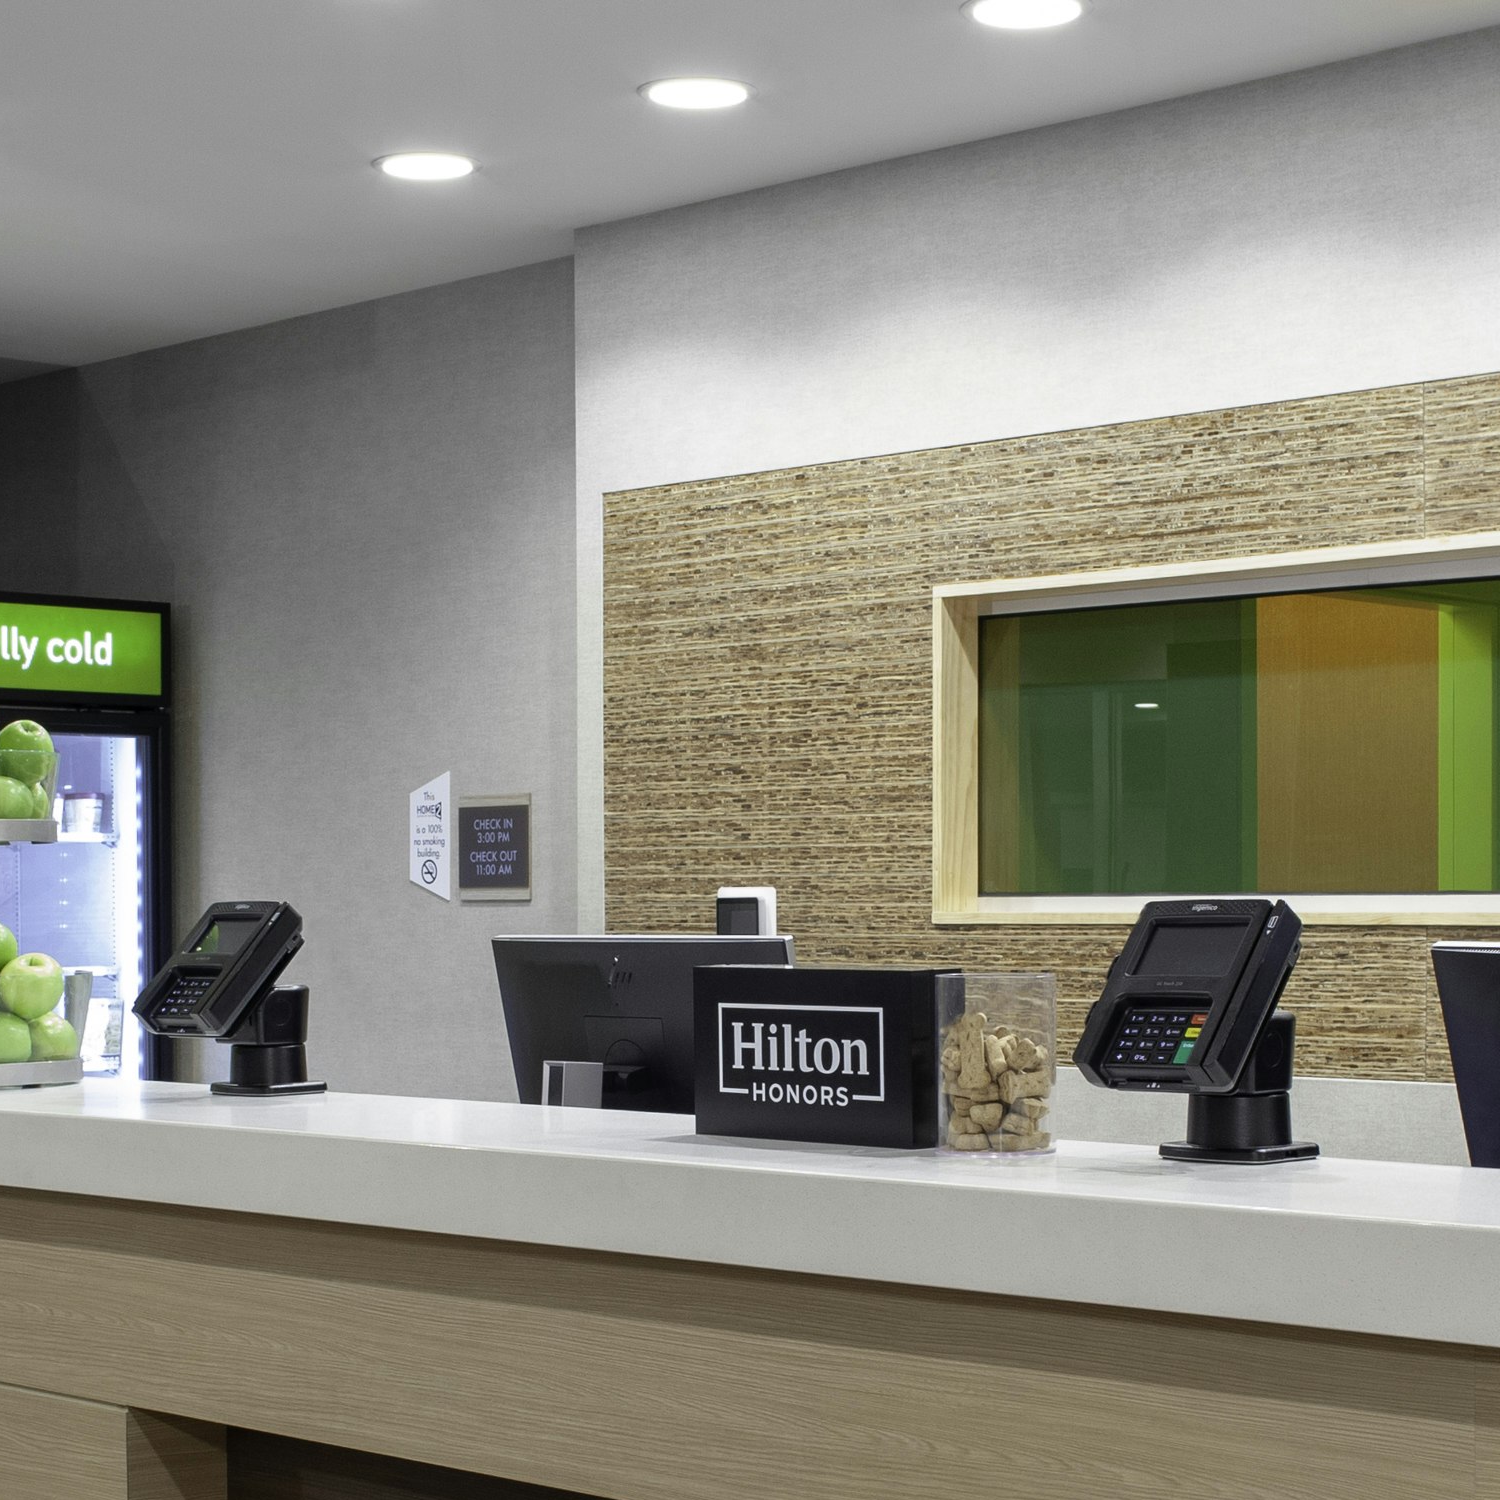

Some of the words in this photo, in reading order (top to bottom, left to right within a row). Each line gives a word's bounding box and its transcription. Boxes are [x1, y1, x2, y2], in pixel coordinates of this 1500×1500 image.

[46, 631, 113, 666] cold
[424, 792, 435, 801] This
[416, 825, 421, 834] is
[428, 824, 443, 834] 100%
[473, 819, 501, 831] CHECK
[503, 819, 513, 829] IN
[422, 836, 445, 848] smoking
[477, 832, 495, 843] 3:00
[498, 832, 510, 842] PM
[470, 851, 498, 863] CHECK
[500, 850, 517, 862] OUT
[476, 865, 496, 876] 11:00
[498, 865, 512, 875] AM
[731, 1022, 870, 1075] Hilton
[752, 1082, 849, 1107] HONORS
